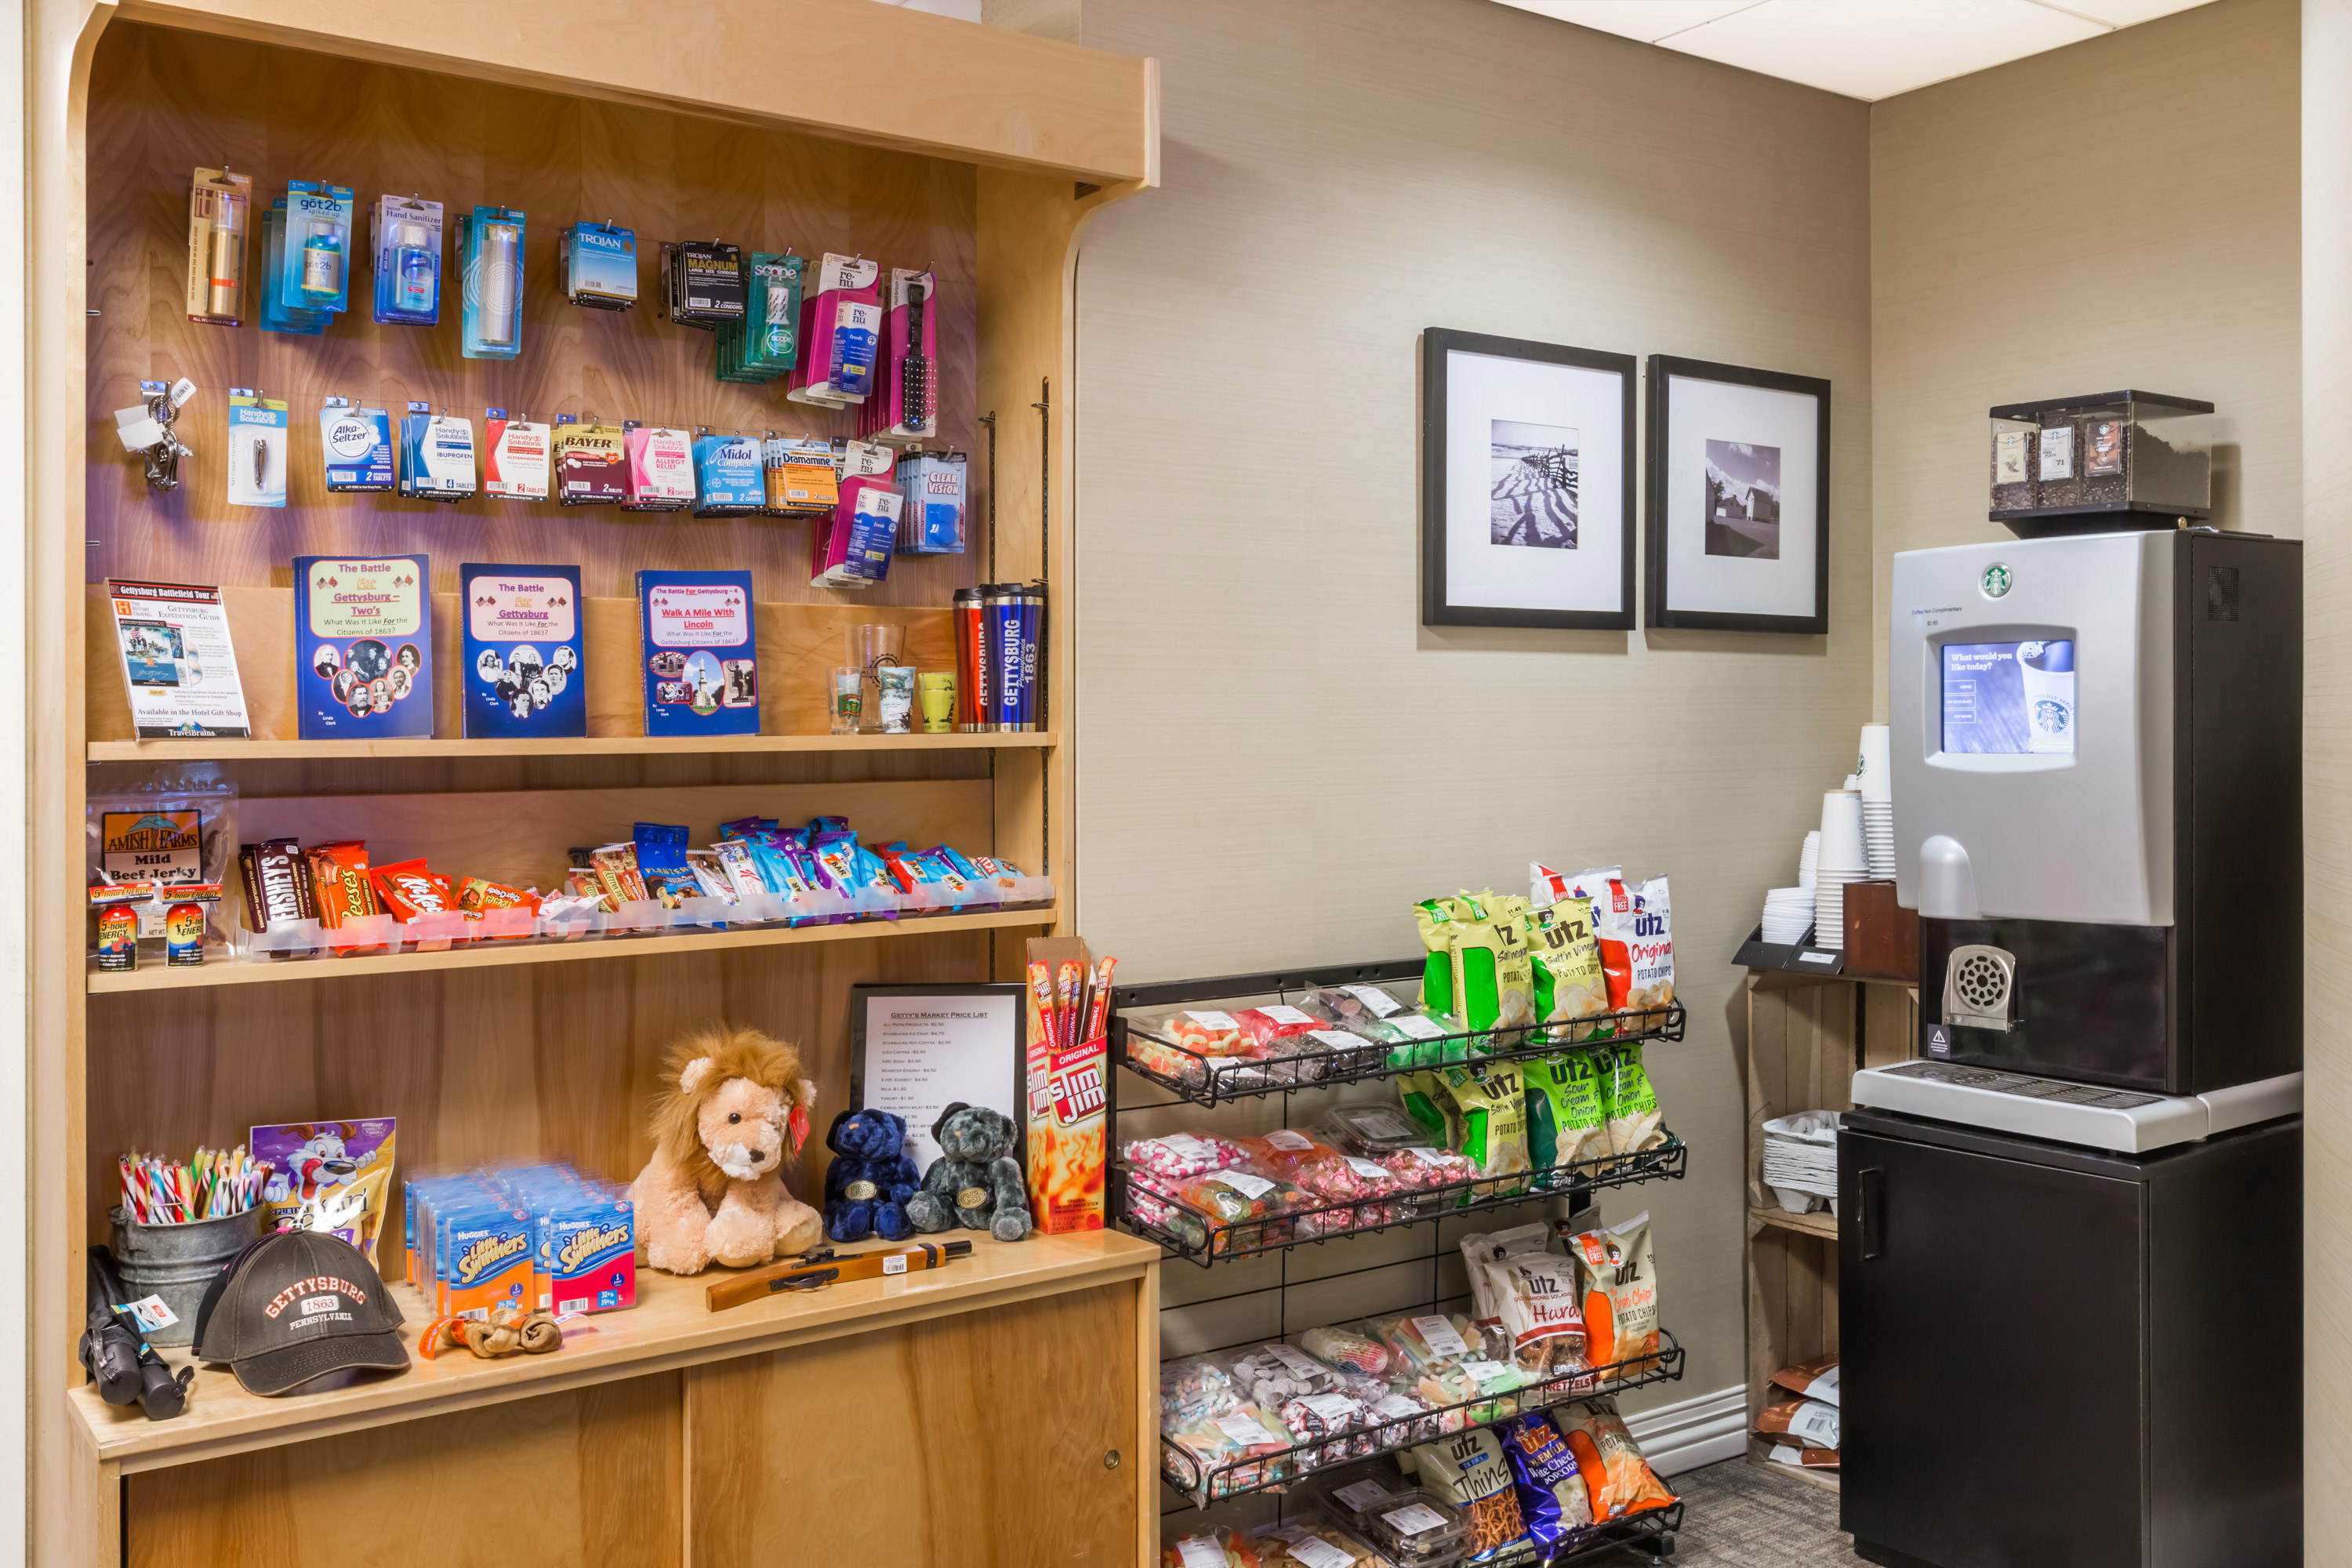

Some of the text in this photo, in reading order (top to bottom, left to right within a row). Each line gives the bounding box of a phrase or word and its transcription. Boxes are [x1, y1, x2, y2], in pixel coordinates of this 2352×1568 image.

[309, 209, 339, 218] spiked-up
[387, 210, 441, 224] Hand Sanitizer
[579, 233, 622, 249] TROJAN
[688, 259, 739, 271] MAGNUM
[754, 265, 797, 281] scope
[714, 299, 720, 308] 2
[240, 408, 264, 418] Handy
[240, 415, 277, 424] Solutions
[334, 426, 360, 434] Alka-
[332, 433, 367, 443] Seltzer
[565, 437, 612, 448] BAYER
[720, 448, 752, 459] Midol
[783, 453, 830, 466] Dramamine
[717, 459, 753, 469] Complete
[929, 471, 957, 484] CLEAR
[519, 484, 524, 492] 2
[361, 564, 391, 572] Battle
[358, 578, 376, 588] For
[121, 586, 210, 599] Gettysburg Battlefield Tour
[334, 593, 391, 603] Gettysburg
[515, 597, 532, 605] For
[499, 610, 548, 619] Gettysburg
[1004, 619, 1020, 706] GETTYSBURG
[1017, 637, 1026, 688] Pennsylvania
[1025, 643, 1035, 683] 1863
[1973, 652, 1997, 661] would
[1998, 652, 2013, 662] you
[1951, 662, 1993, 671] like today?
[107, 829, 198, 851] AMISH FARMS
[135, 854, 171, 866] Mild
[111, 867, 196, 881] Beef Jerky
[831, 861, 848, 877] BAR
[397, 877, 426, 894] Kit
[165, 890, 219, 900] 5-hour ENERGY
[408, 894, 444, 913] Kat
[1613, 901, 1628, 912] FREE
[101, 920, 128, 931] 5-hour
[100, 928, 127, 940] ENERGY
[1632, 940, 1672, 966] Original
[1637, 965, 1671, 981] POTATO CHIPS
[1044, 1012, 1056, 1047] ORIGINAL
[1029, 1044, 1047, 1058] ORIGINAL
[1058, 1044, 1099, 1065] ORIGINAL
[1564, 1083, 1589, 1096] Sour
[1560, 1093, 1591, 1108] Cream
[1570, 1105, 1597, 1119] Onion
[1606, 1097, 1658, 1123] POTATO CHIPS
[849, 1184, 870, 1196] US
[960, 1189, 980, 1205] CS
[559, 1221, 590, 1232] HUGGIES
[264, 1276, 367, 1319] GETTYSBURG
[1613, 1289, 1652, 1312] Crab Chip
[306, 1299, 335, 1311] 1863
[289, 1312, 353, 1330] PENNSYLVANIA
[1617, 1305, 1656, 1325] POTATO CHIPS
[1453, 1458, 1510, 1501] Thins
[1544, 1461, 1578, 1485] POPCORN
